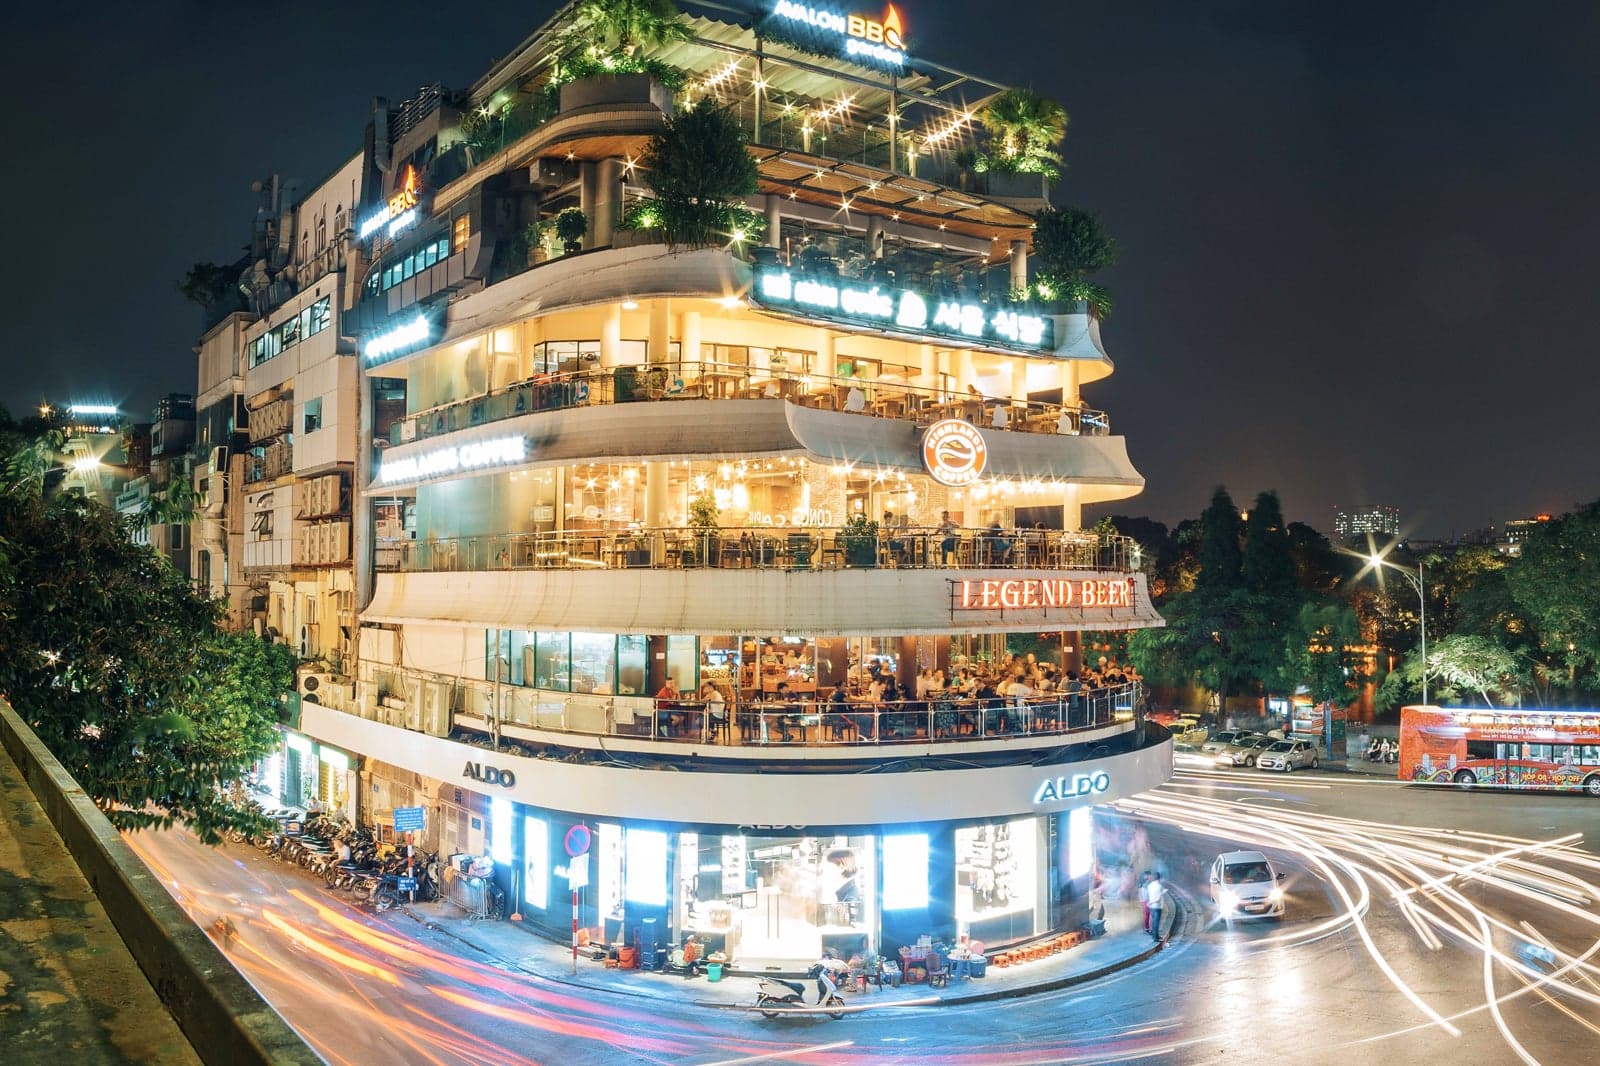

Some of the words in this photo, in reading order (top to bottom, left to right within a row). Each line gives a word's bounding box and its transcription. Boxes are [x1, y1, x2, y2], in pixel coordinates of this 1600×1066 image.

[774, 0, 846, 33] AVALON
[848, 9, 906, 50] BBQ
[962, 579, 1073, 608] LEGEND
[1080, 579, 1131, 607] BEER
[1511, 727, 1530, 735] CITY
[463, 761, 516, 788] ALDO
[1034, 770, 1110, 803] ALDO
[1522, 773, 1536, 782] HOP
